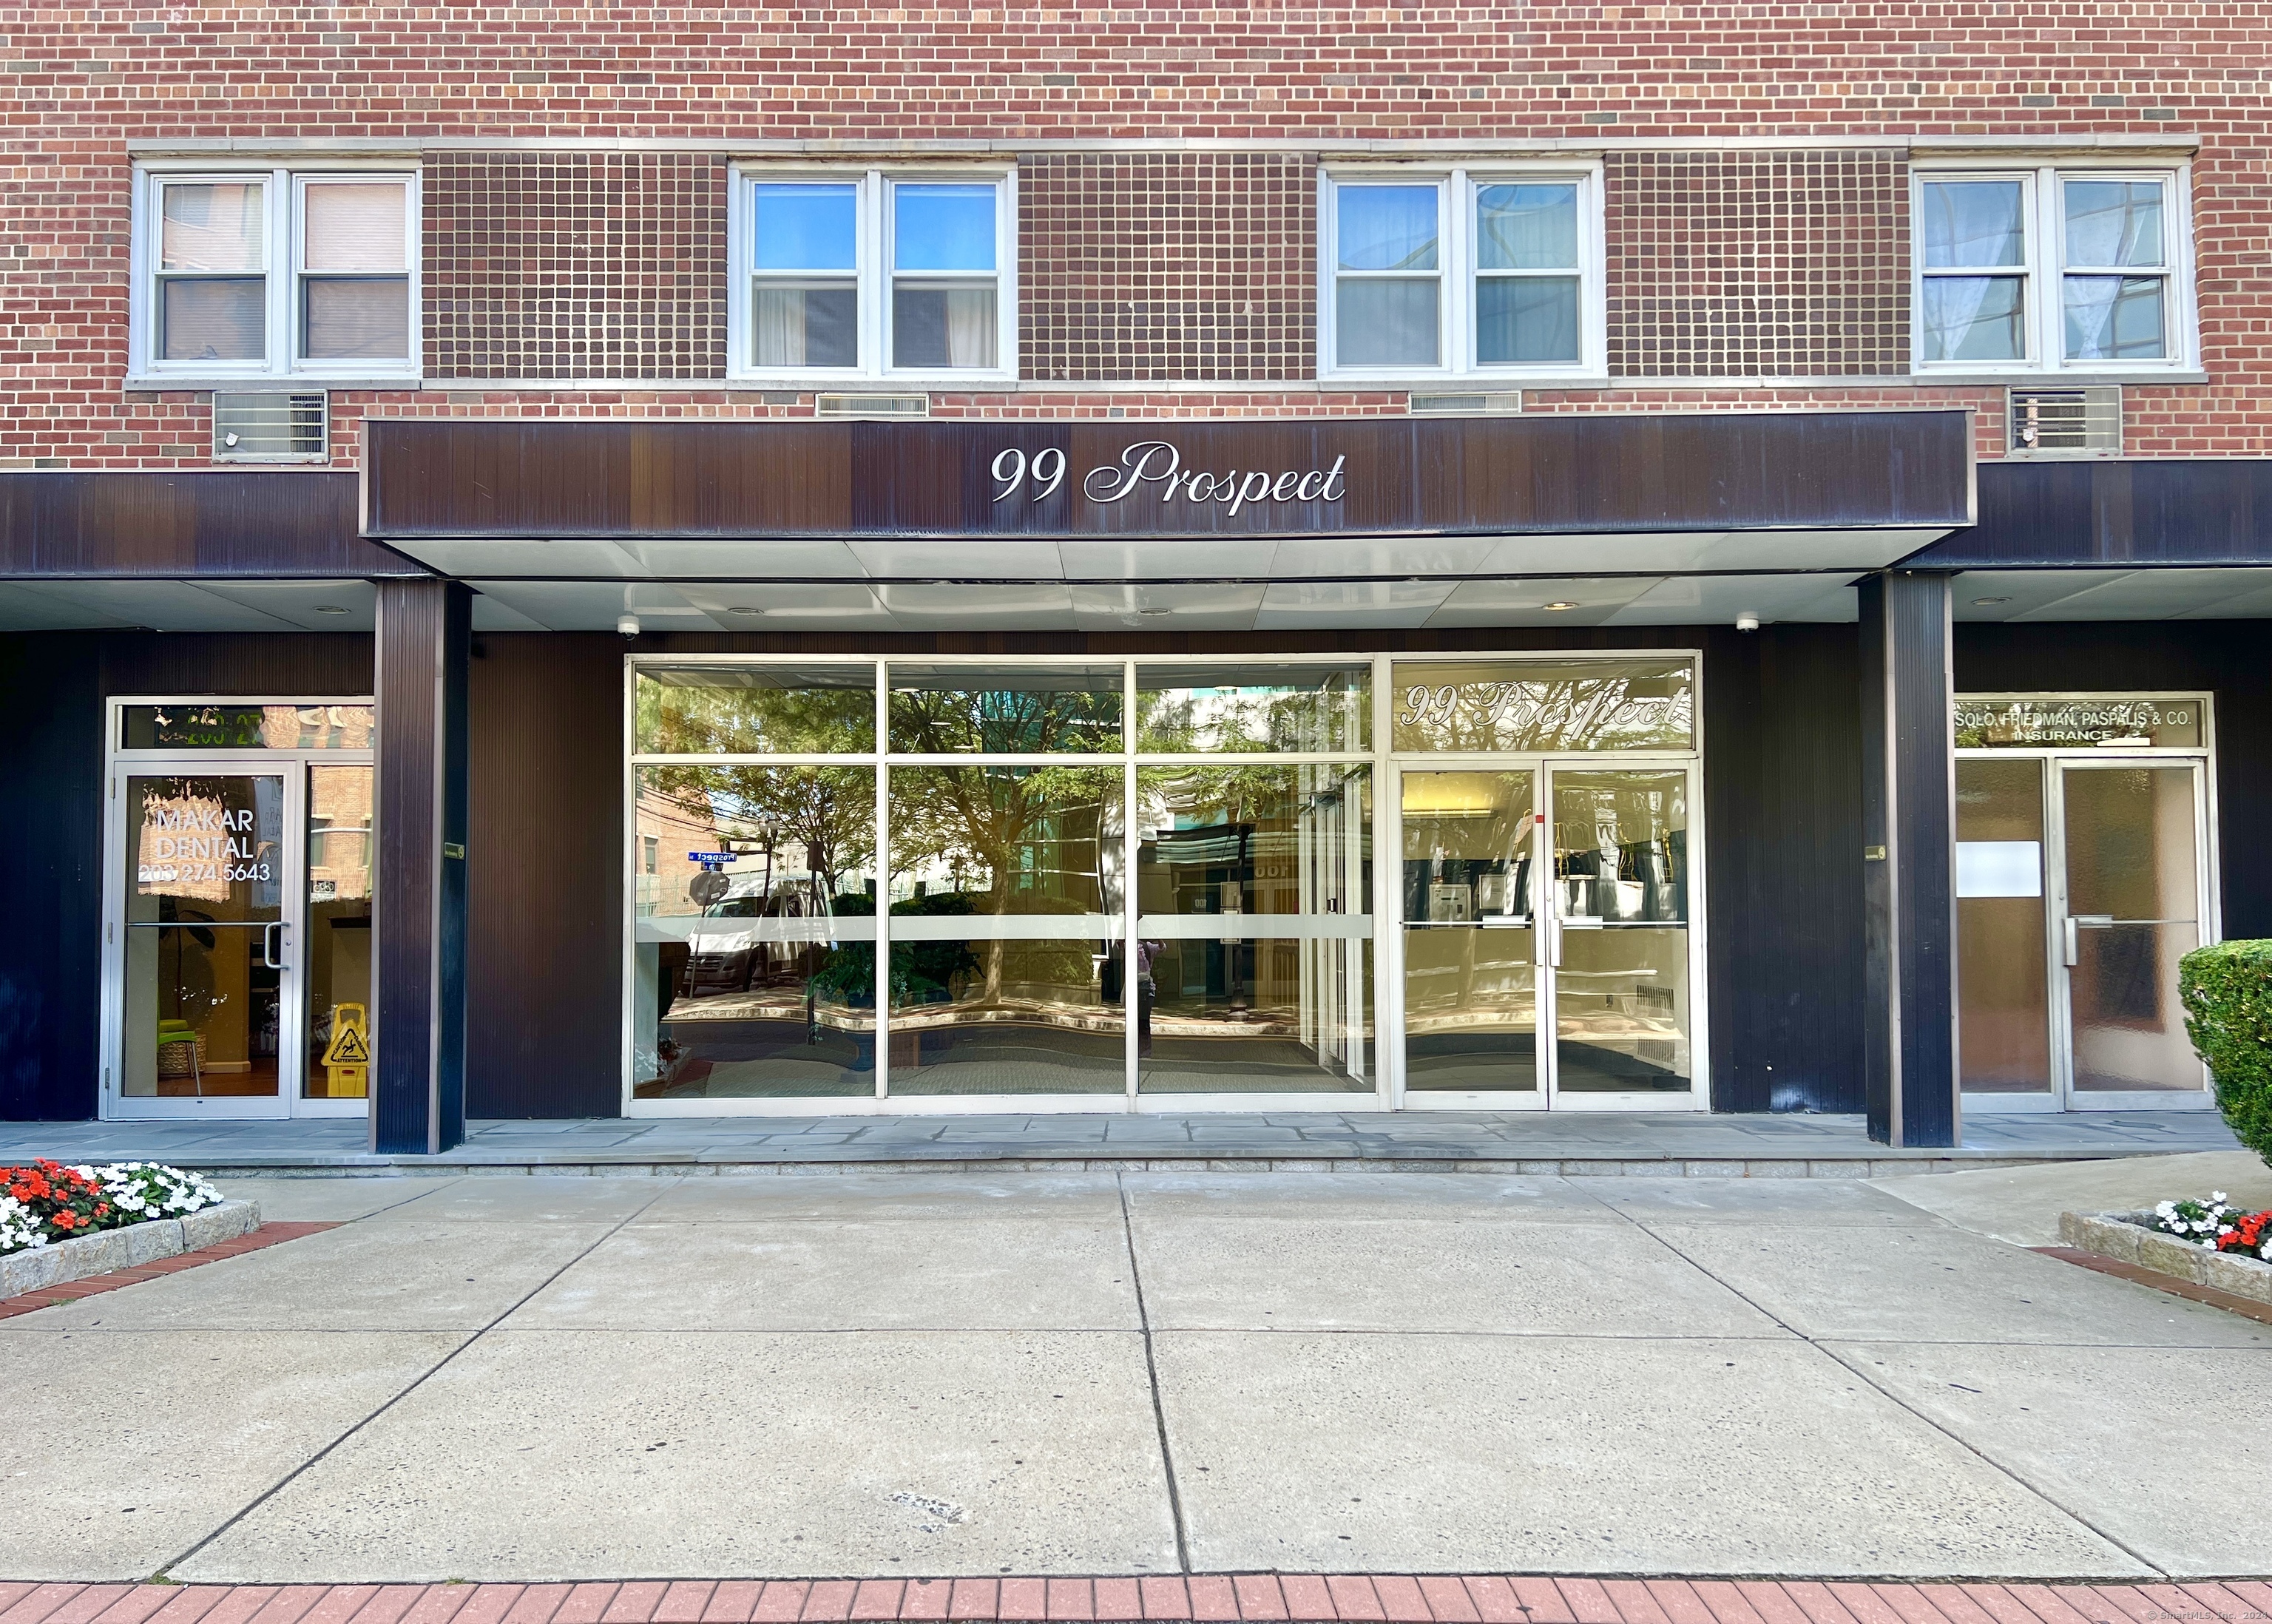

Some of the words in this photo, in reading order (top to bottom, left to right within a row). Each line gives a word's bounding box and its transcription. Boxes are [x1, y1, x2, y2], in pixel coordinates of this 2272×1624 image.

[991, 447, 1066, 502] 99
[1083, 441, 1346, 516] Prospect
[1400, 684, 1458, 725] 99
[1472, 681, 1688, 740] Prospect
[2082, 711, 2148, 726] PASPALIS
[2151, 711, 2162, 725] &
[2166, 711, 2192, 725] CO.
[2013, 731, 2113, 741] INSURANCE
[157, 810, 254, 832] MAKAR
[157, 836, 254, 859] DENTAL
[138, 863, 271, 882] 203.274.5643
